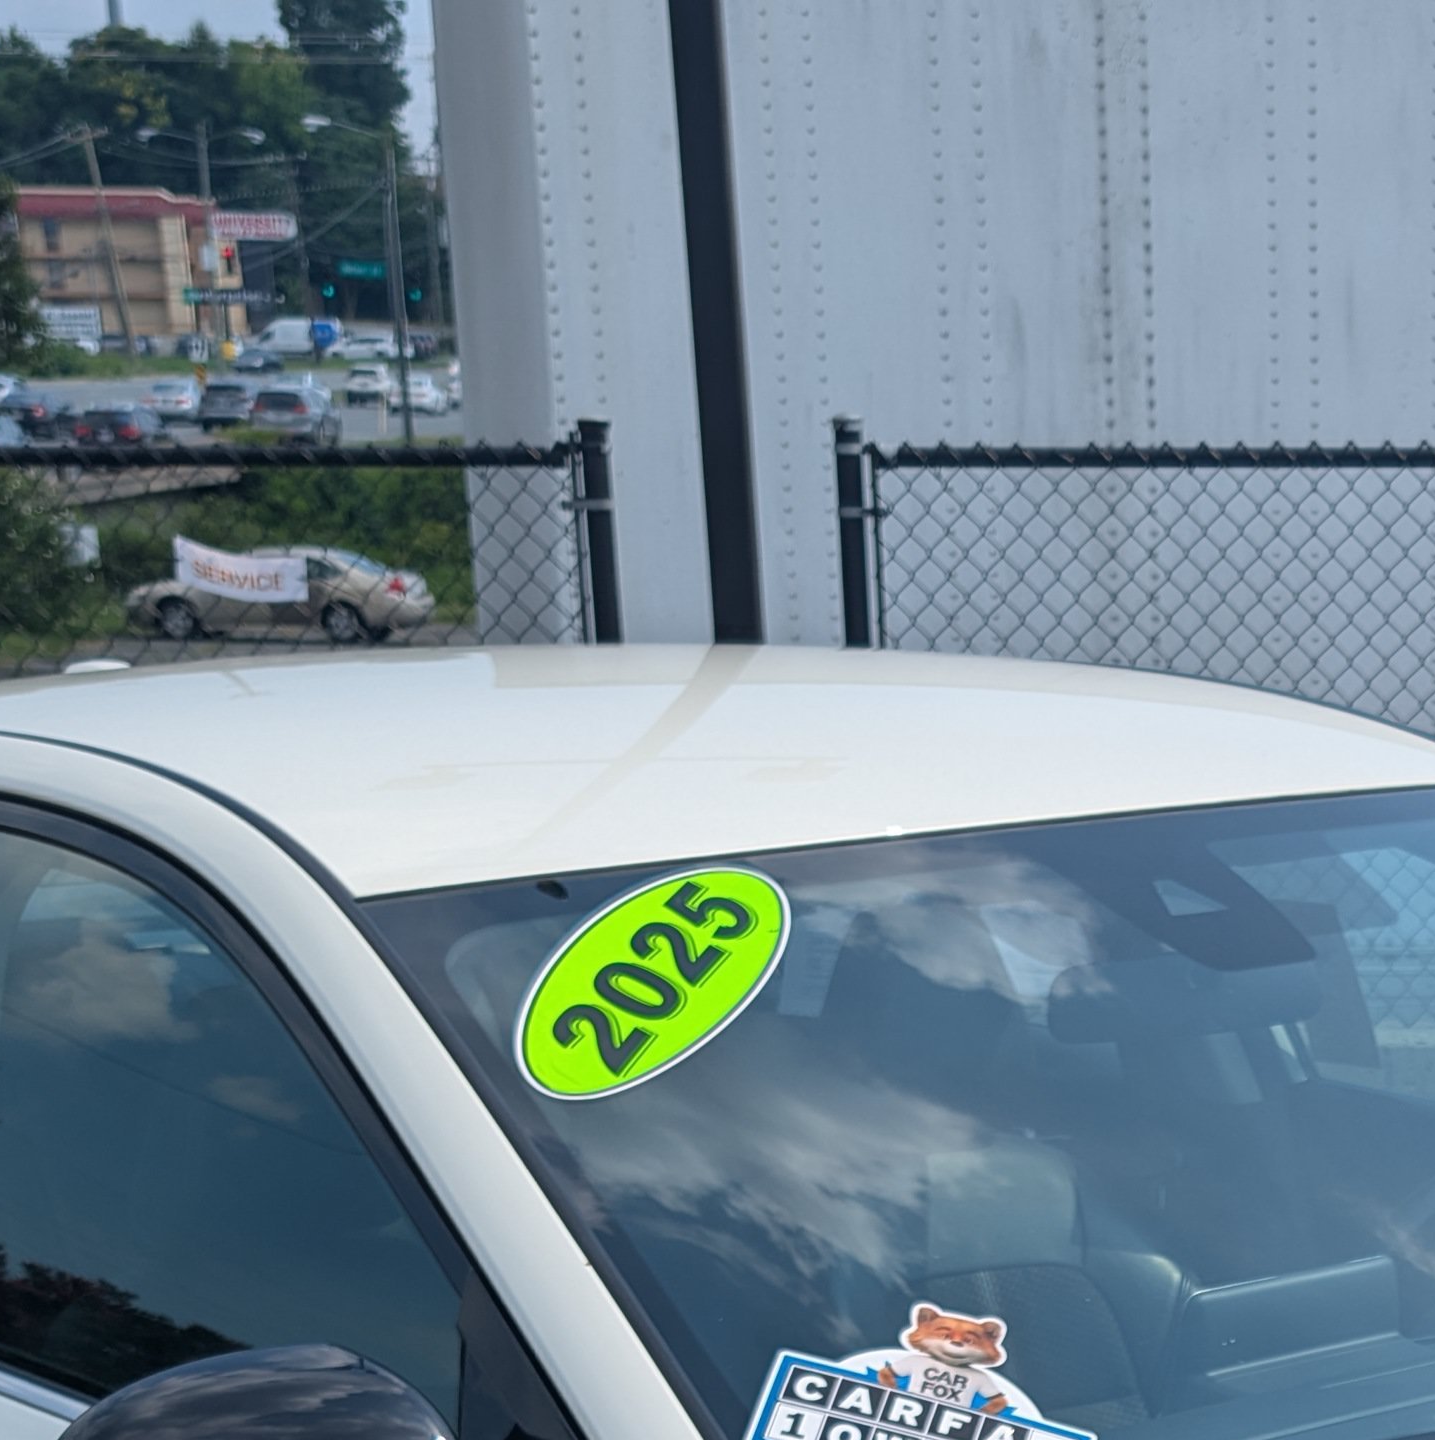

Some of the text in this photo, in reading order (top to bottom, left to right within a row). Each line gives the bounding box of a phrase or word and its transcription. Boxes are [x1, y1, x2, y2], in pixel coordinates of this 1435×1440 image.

[191, 560, 284, 591] SERVICE
[552, 881, 757, 1077] 2025
[920, 1380, 963, 1402] FOX
[924, 1367, 969, 1389] CAR
[779, 1412, 807, 1440] 1
